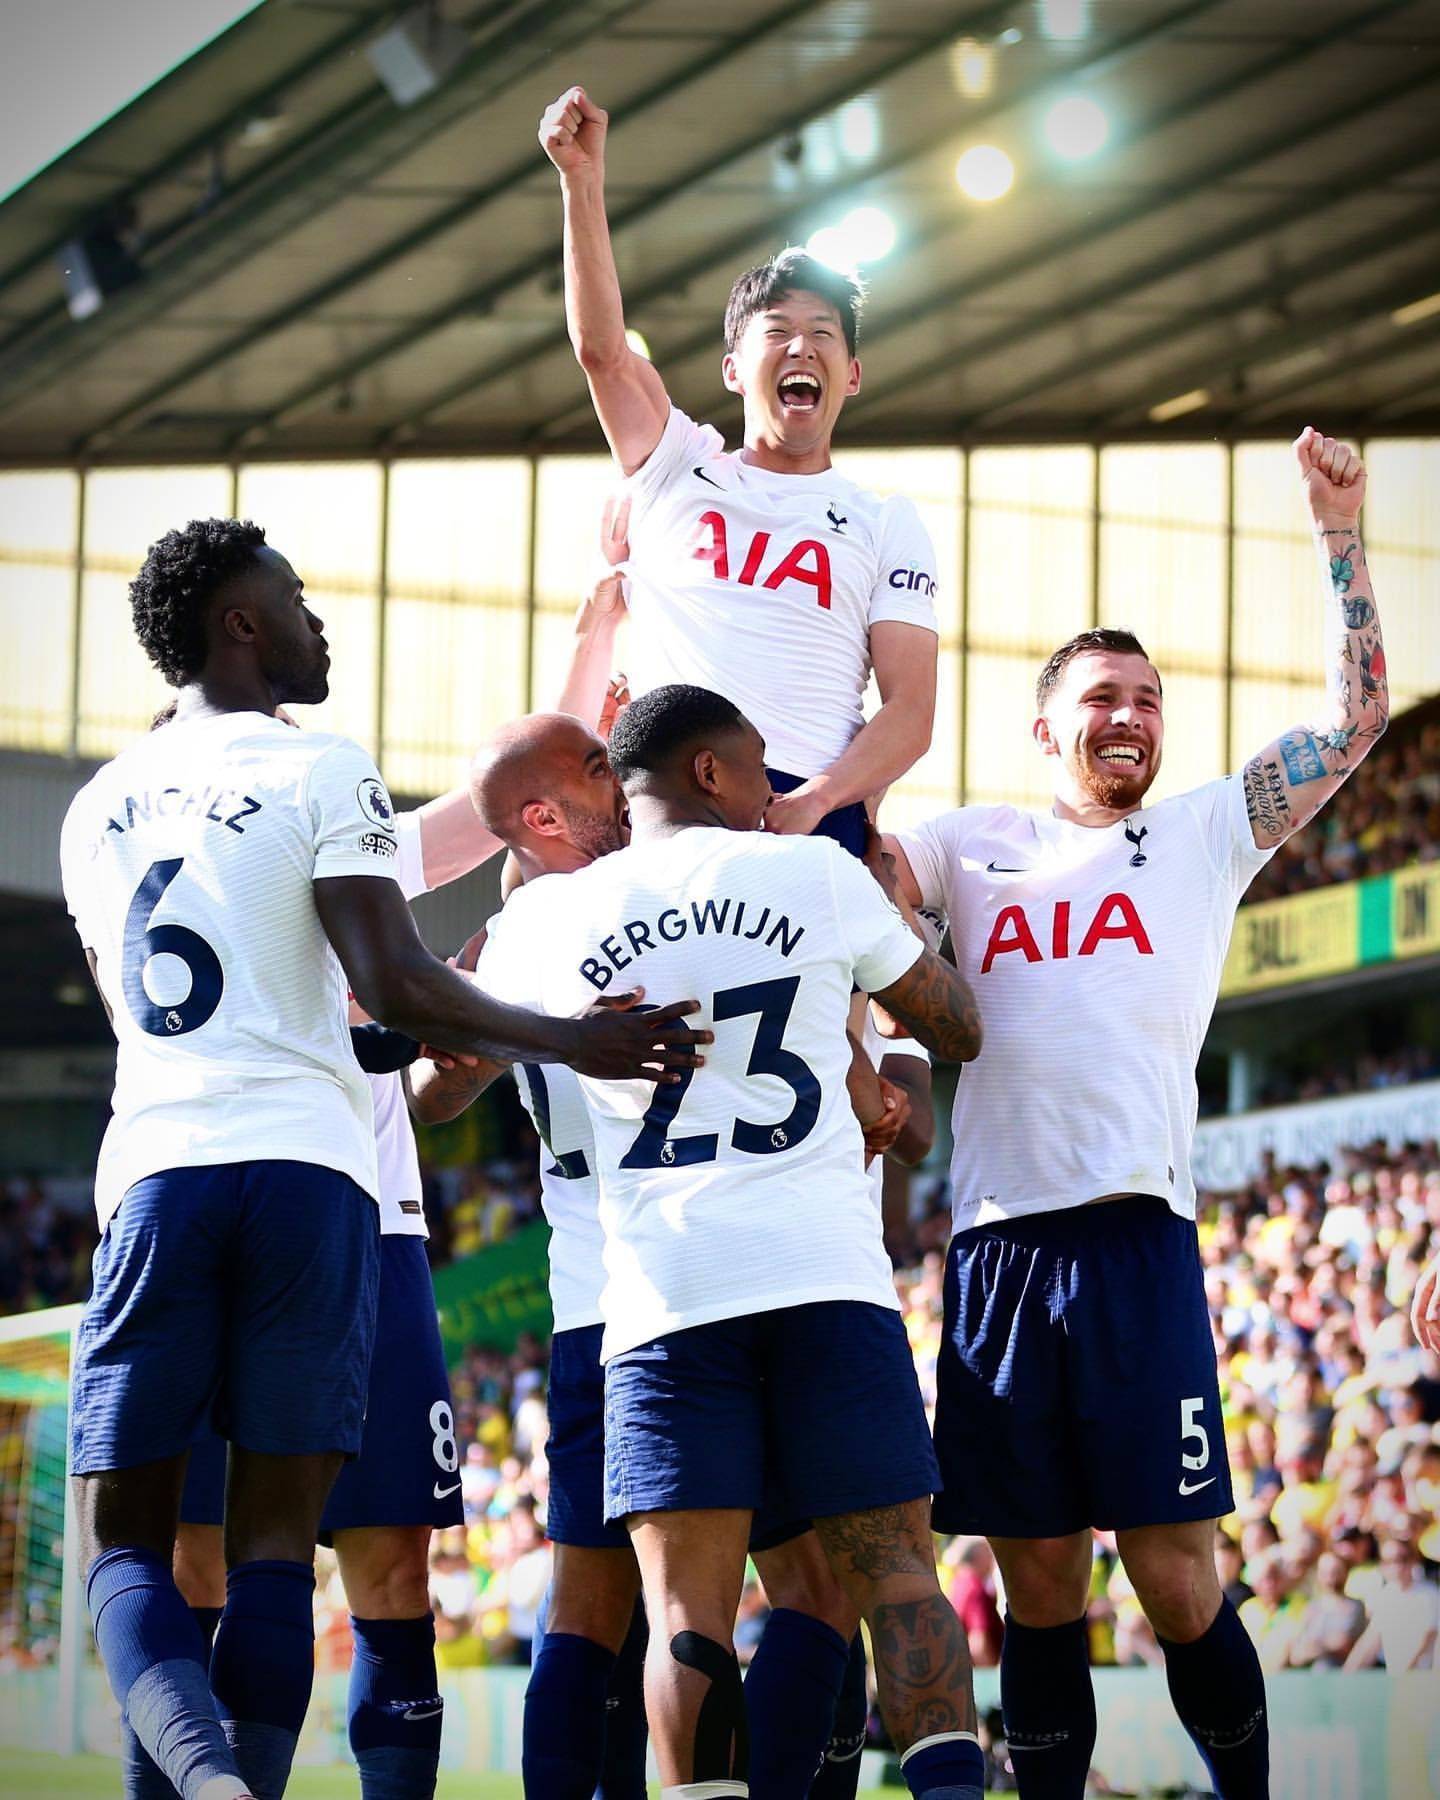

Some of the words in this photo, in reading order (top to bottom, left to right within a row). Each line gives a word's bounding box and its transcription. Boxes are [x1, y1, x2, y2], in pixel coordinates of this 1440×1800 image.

[690, 510, 832, 610] AIA
[888, 560, 938, 599] cinc
[121, 857, 224, 1037] 6
[578, 898, 805, 991] BERGWIJN
[980, 892, 1154, 974] AIA
[618, 974, 822, 1169] 23
[429, 1400, 458, 1473] 8
[1181, 1397, 1210, 1471] 5
